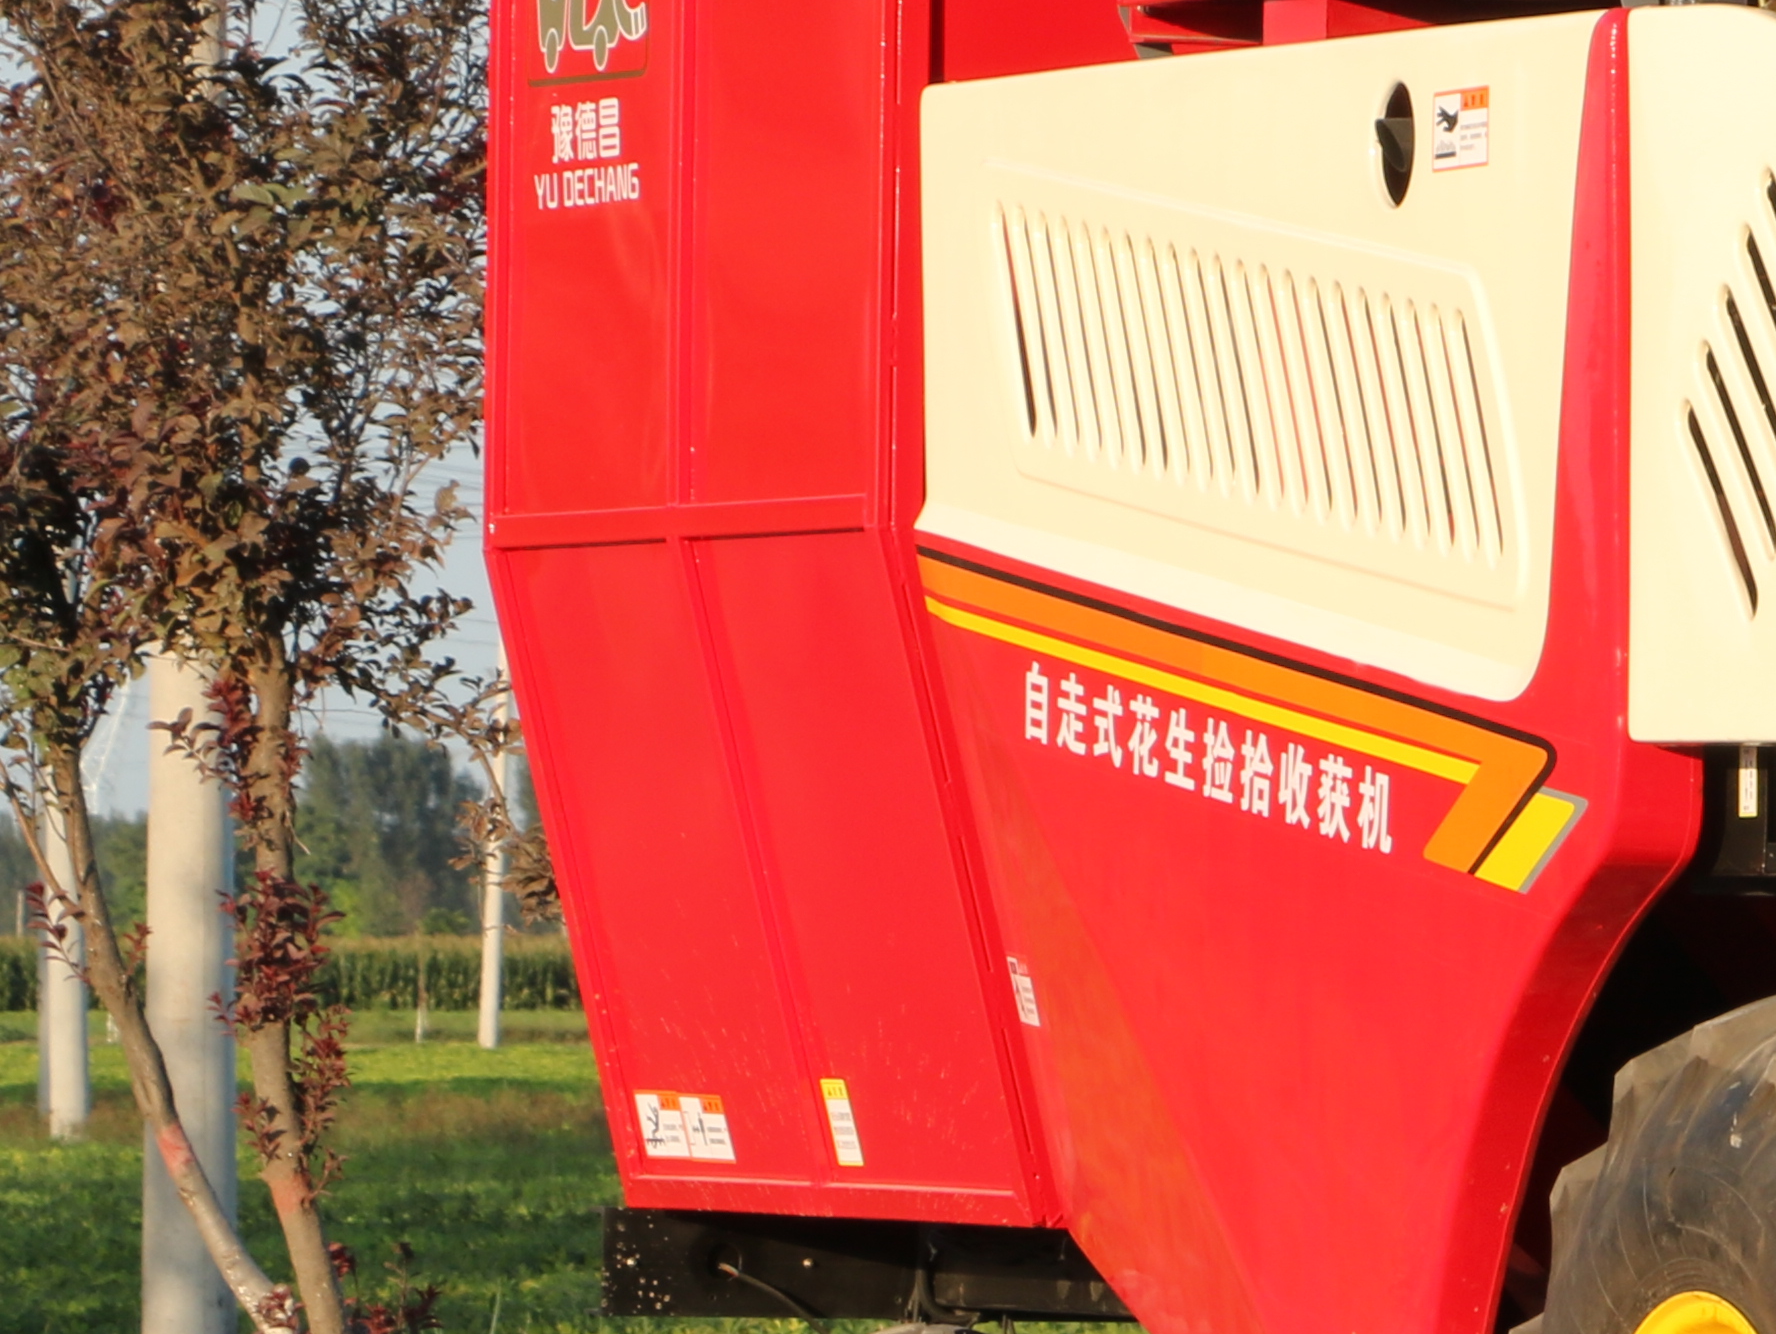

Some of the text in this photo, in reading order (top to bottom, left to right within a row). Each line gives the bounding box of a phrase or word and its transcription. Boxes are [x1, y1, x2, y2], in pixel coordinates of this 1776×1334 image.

[551, 97, 620, 163] 豫德昌
[534, 163, 639, 209] YU DECHANG
[1023, 661, 1392, 854] 自走式花生捡拾收获机
